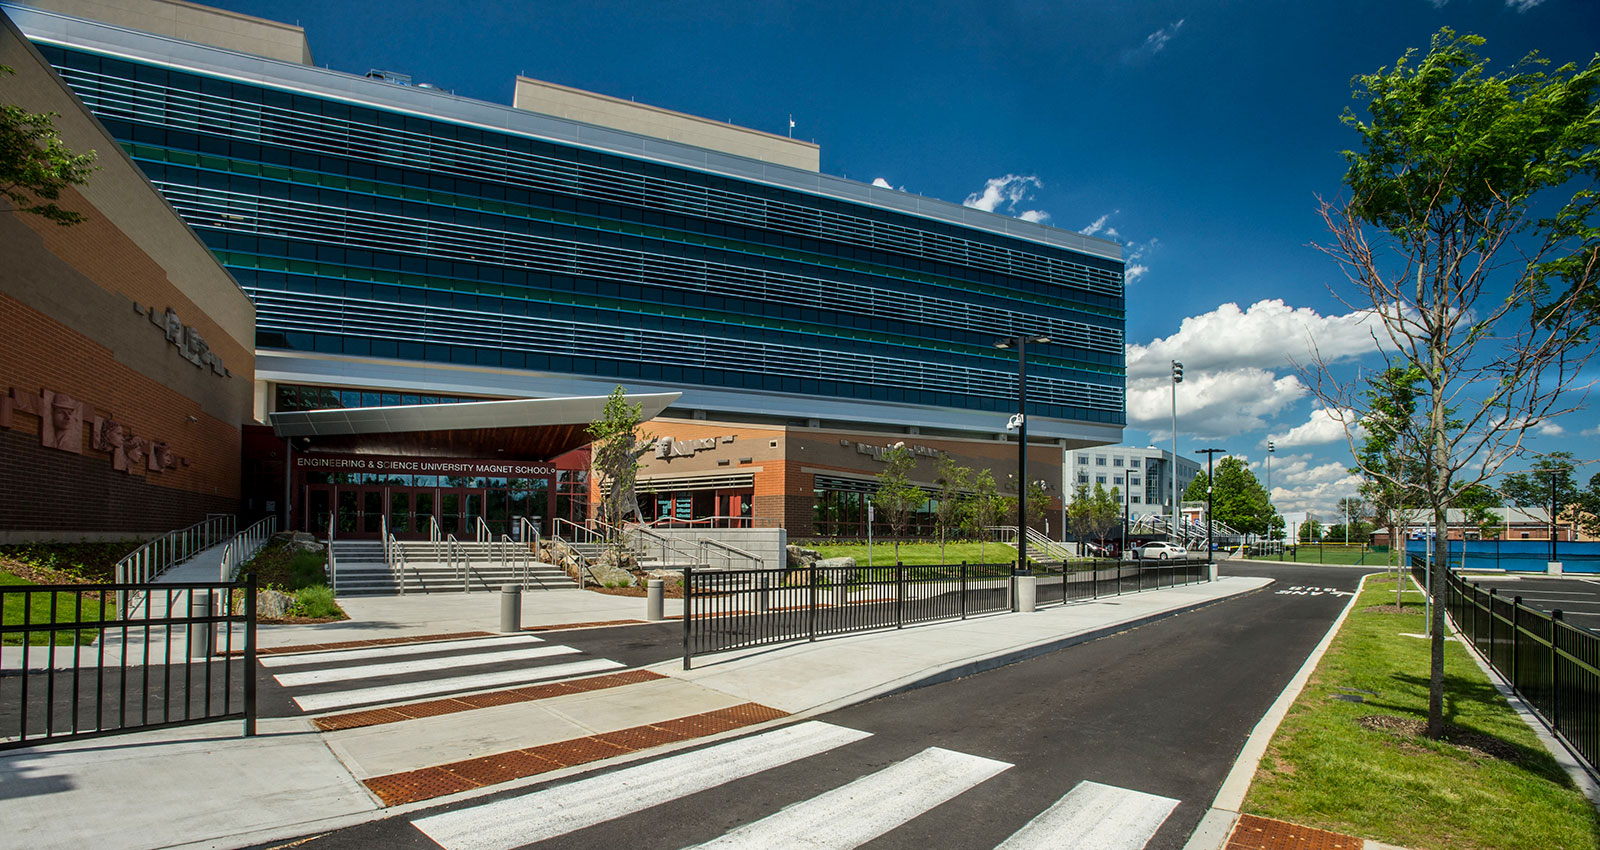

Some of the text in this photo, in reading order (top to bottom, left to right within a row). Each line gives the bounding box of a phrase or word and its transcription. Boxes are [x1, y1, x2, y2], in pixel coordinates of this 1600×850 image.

[297, 458, 551, 475] ENGINEERING & SCIENCE UNIVERSITY MAGNET SCHOOL
